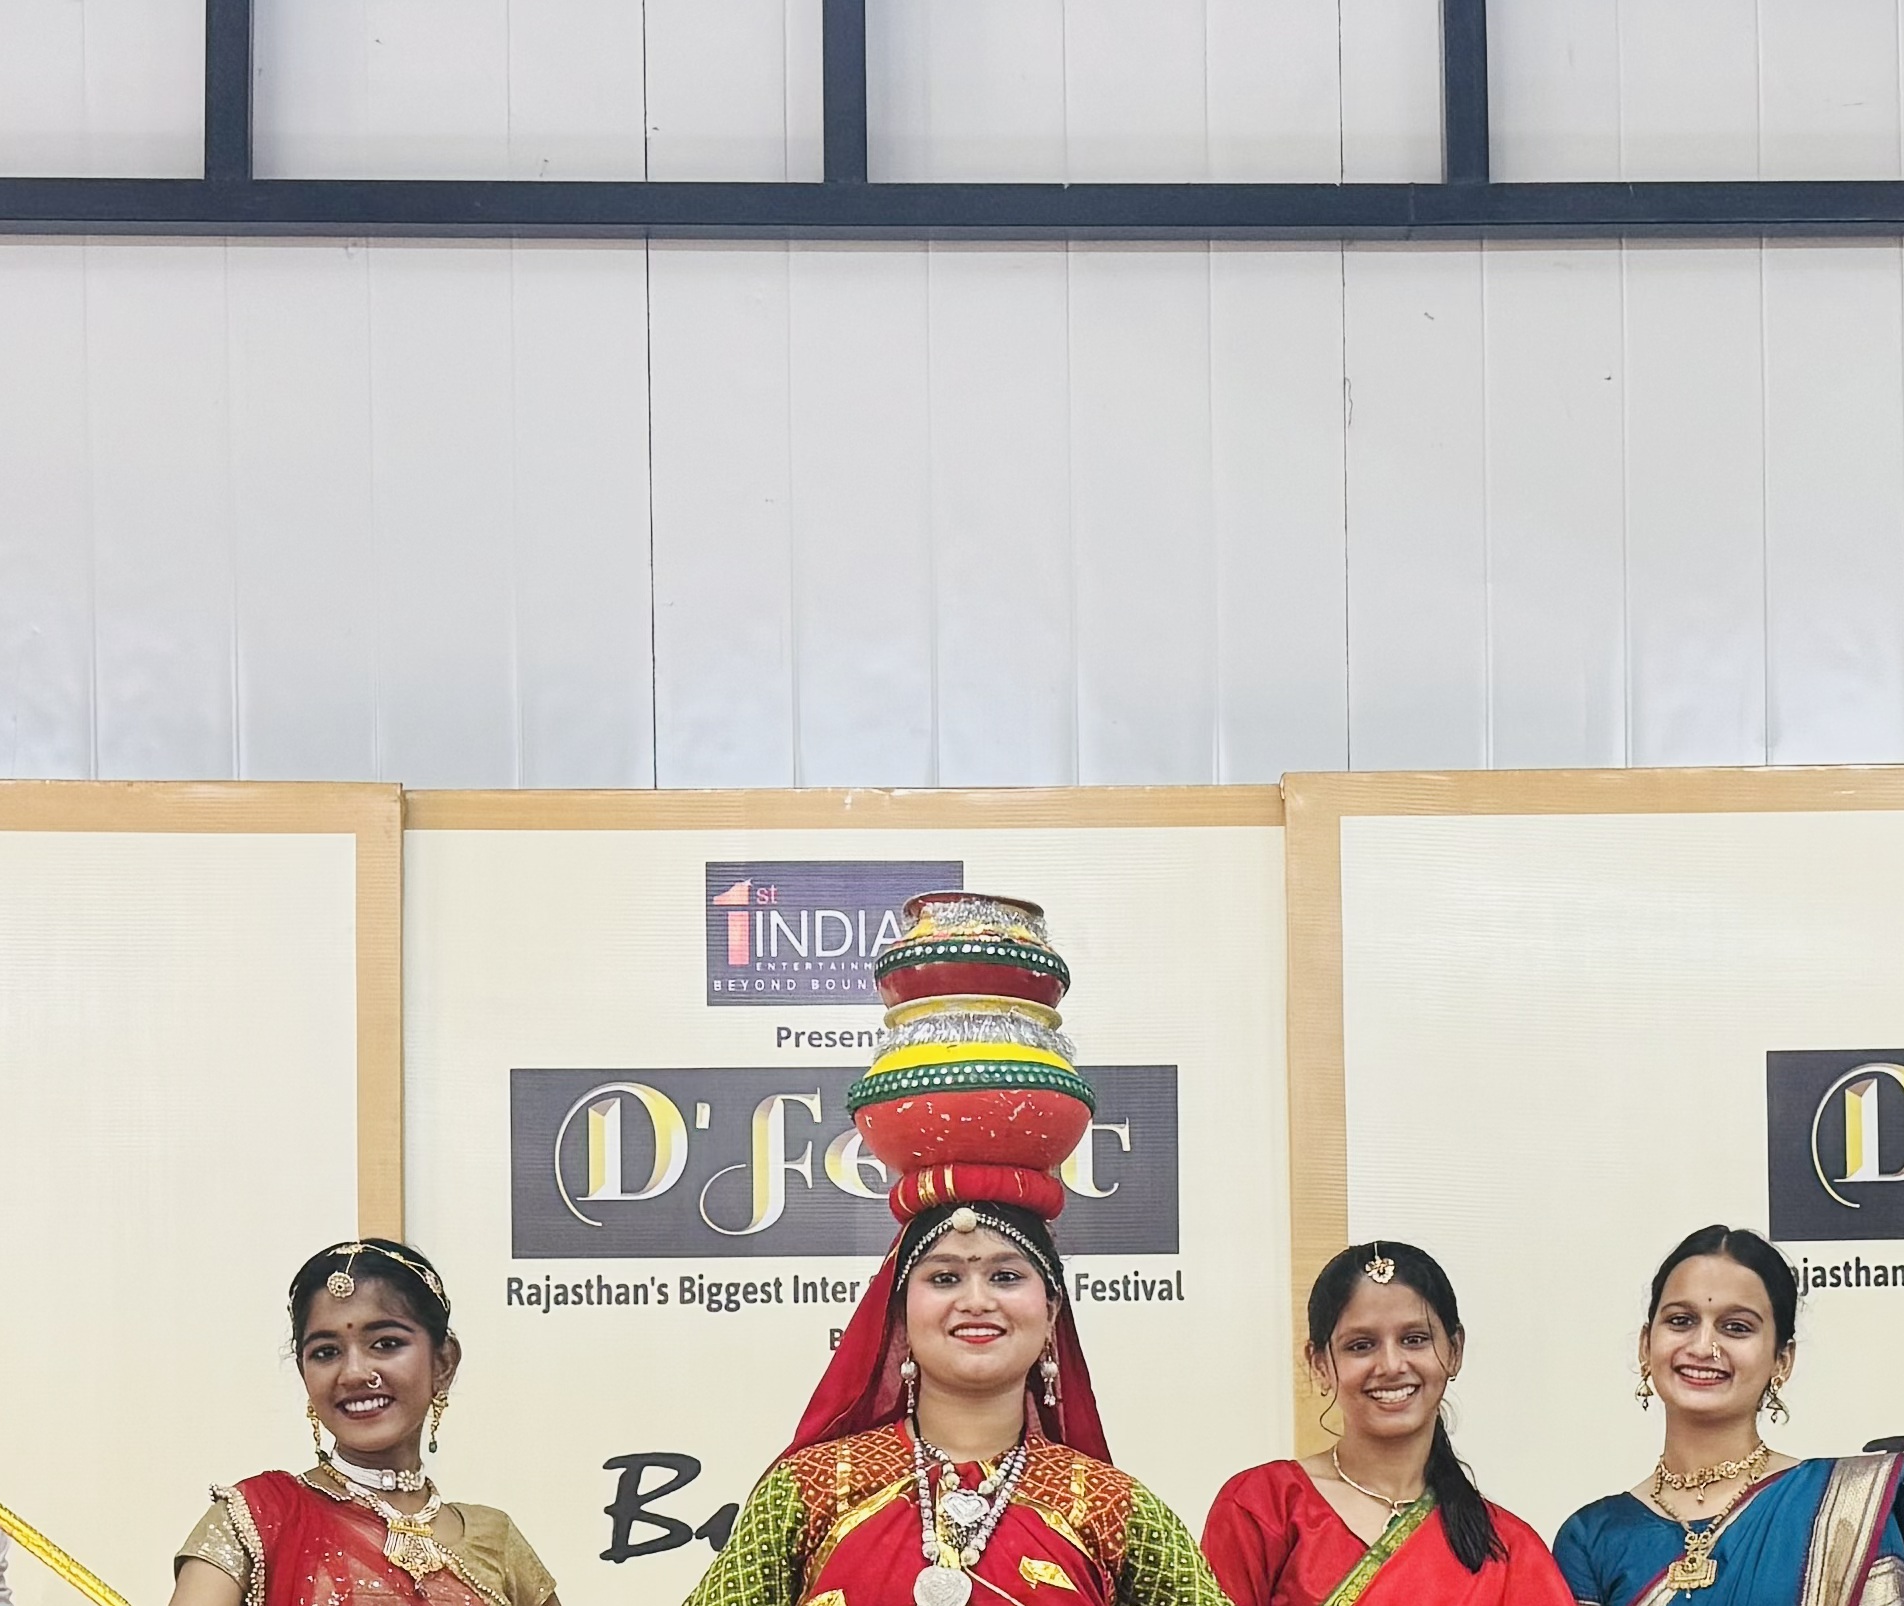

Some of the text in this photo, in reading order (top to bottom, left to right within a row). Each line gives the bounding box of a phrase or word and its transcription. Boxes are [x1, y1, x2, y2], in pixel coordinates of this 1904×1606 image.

[755, 962, 873, 972] ENTERTAINM
[713, 979, 797, 992] BEYOND
[506, 1269, 1185, 1314] Rajasthan's Biggest Inter Festival
